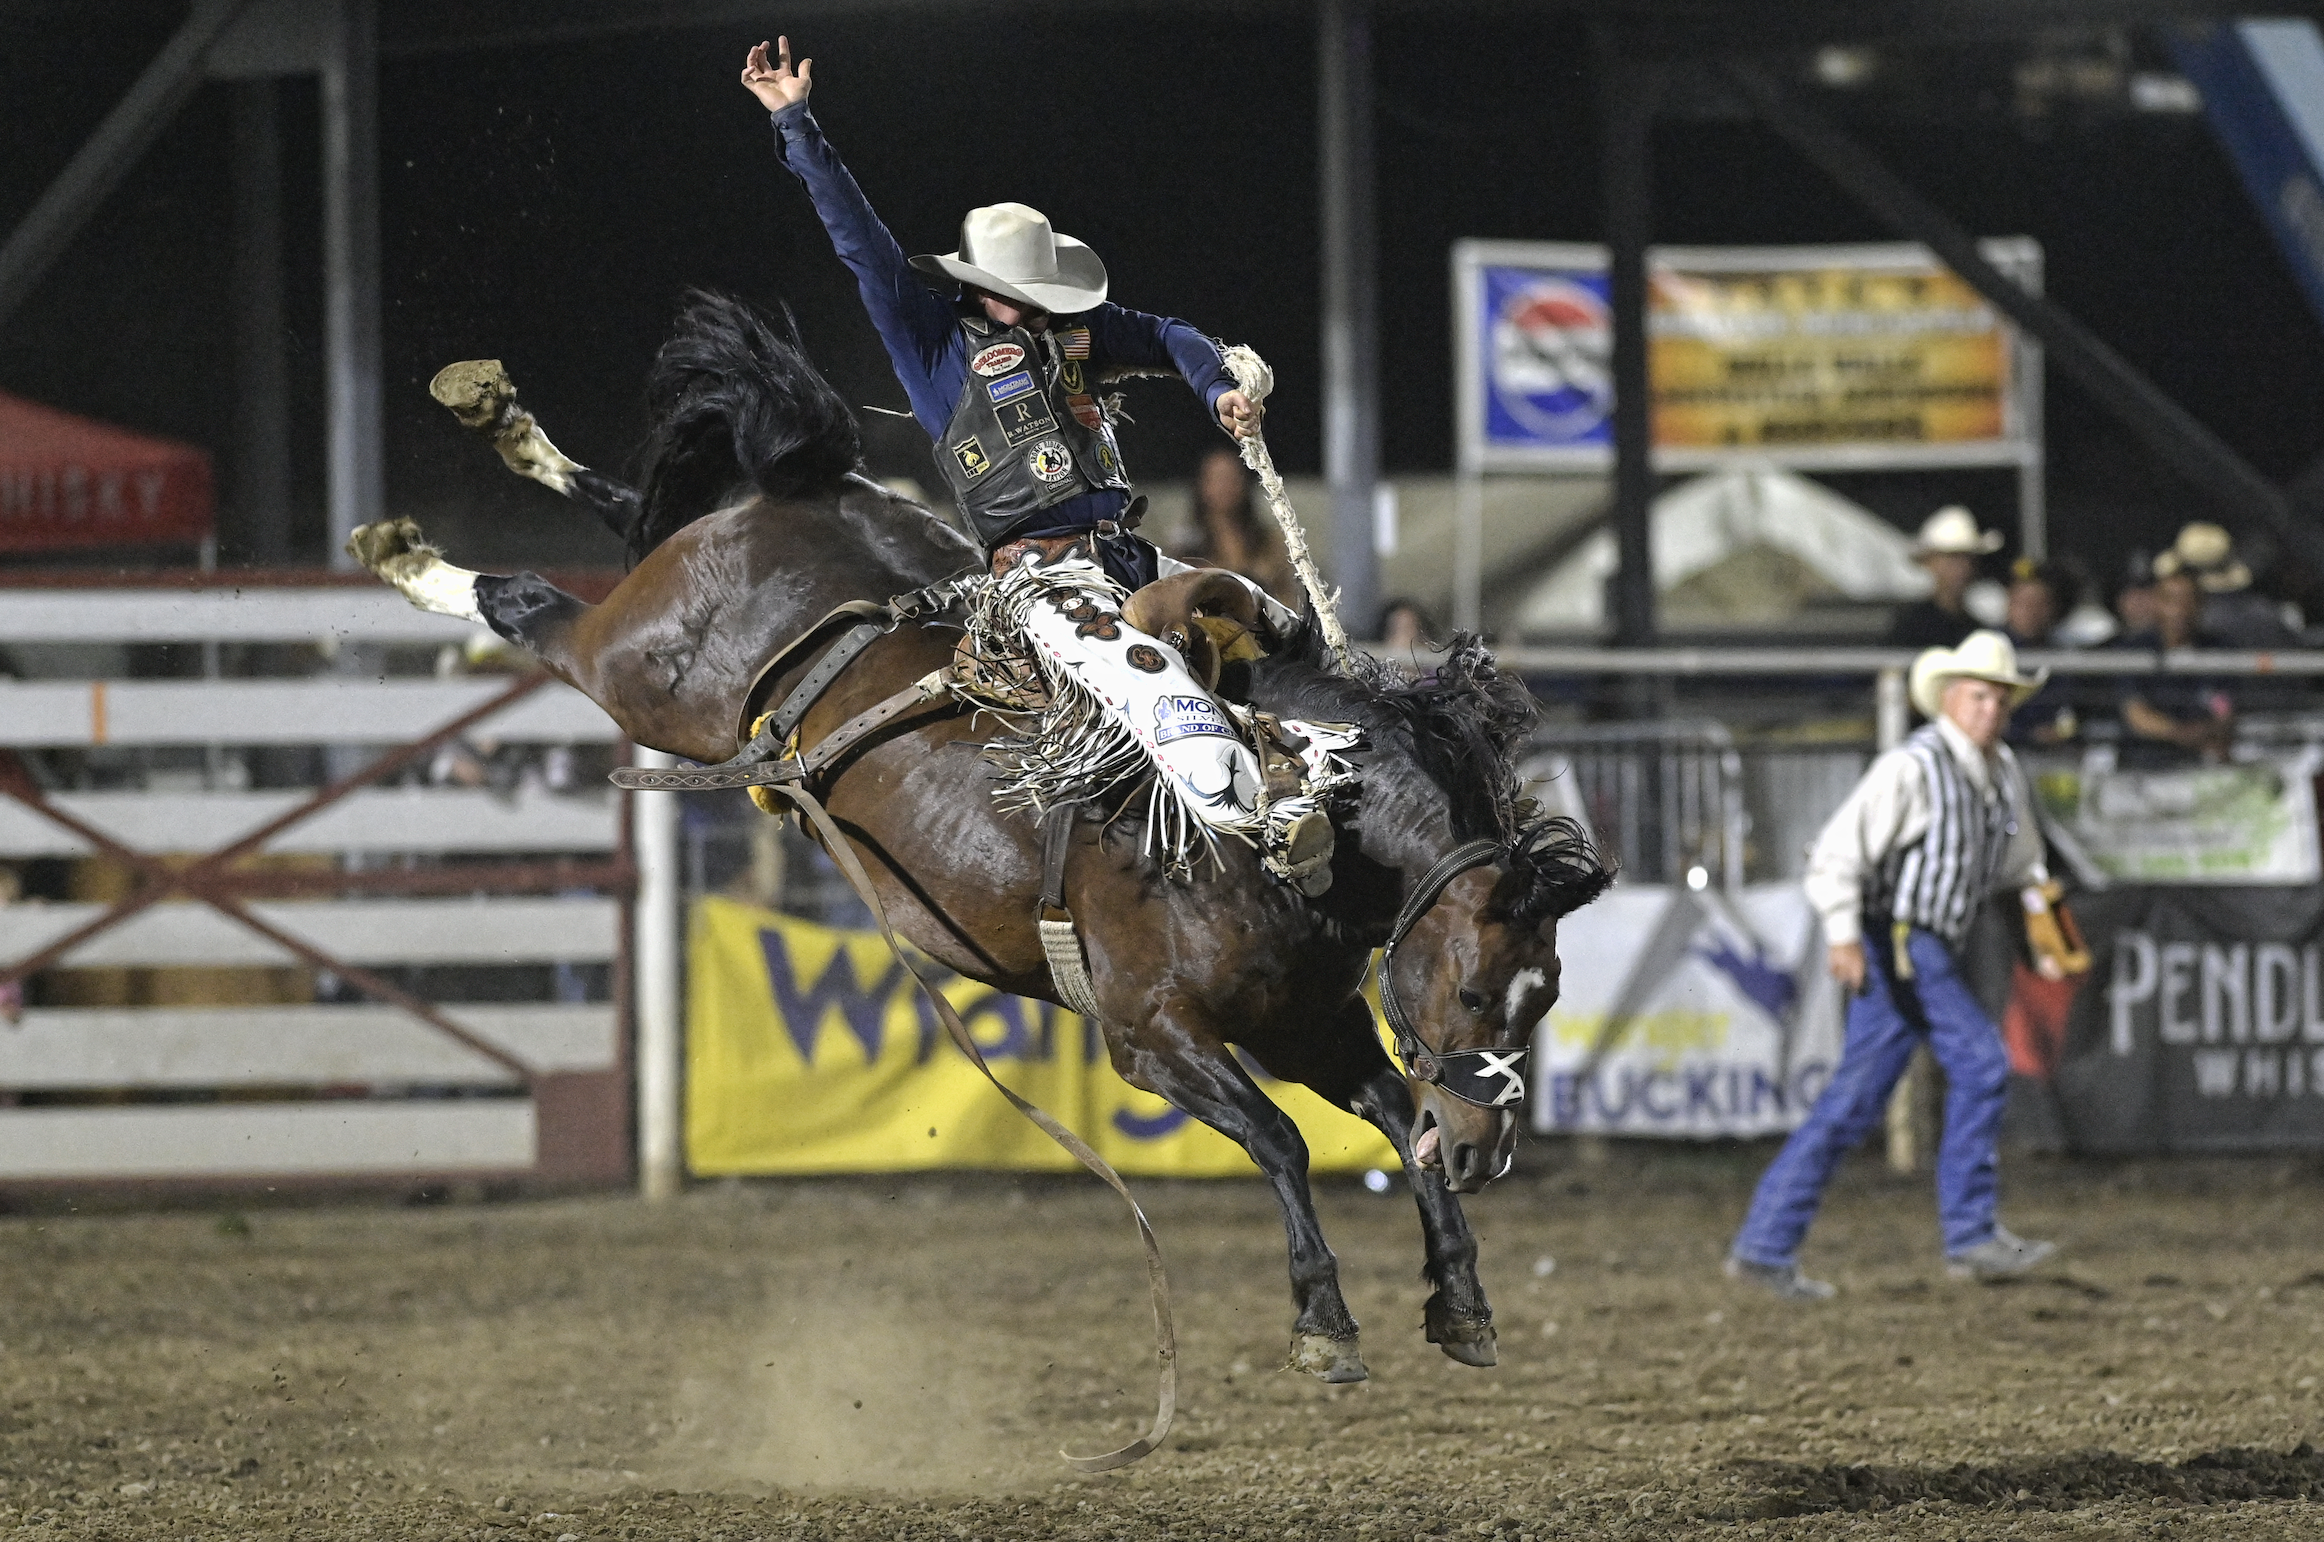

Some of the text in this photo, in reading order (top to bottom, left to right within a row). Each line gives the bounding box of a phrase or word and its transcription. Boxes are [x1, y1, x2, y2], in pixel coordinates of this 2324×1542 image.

[1015, 402, 1032, 422] R
[1045, 467, 1069, 481] NATION
[1202, 724, 1218, 732] OF
